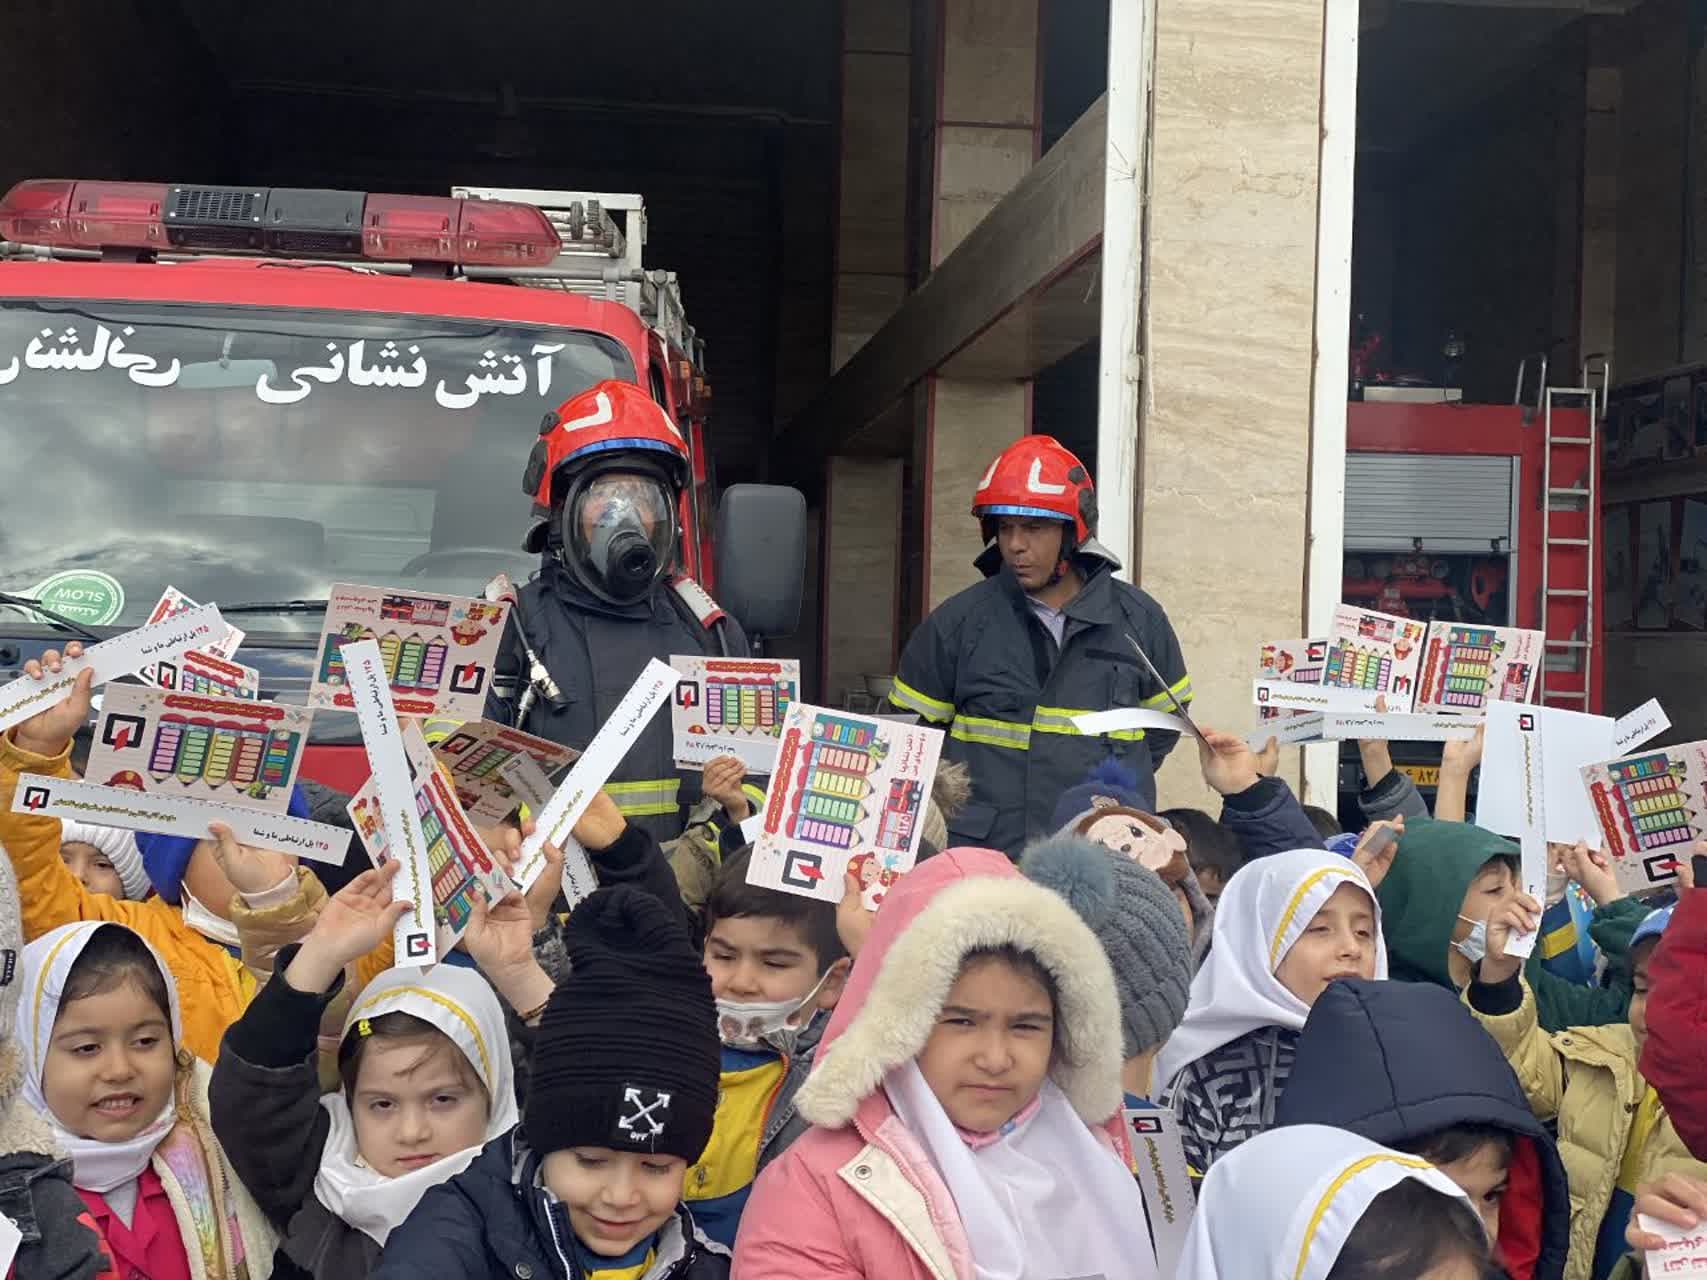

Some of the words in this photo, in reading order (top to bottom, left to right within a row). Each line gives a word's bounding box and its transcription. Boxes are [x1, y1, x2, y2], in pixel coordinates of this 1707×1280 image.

[255, 339, 428, 404] نشانی
[435, 343, 566, 409] آتش
[55, 588, 105, 602] SLOW
